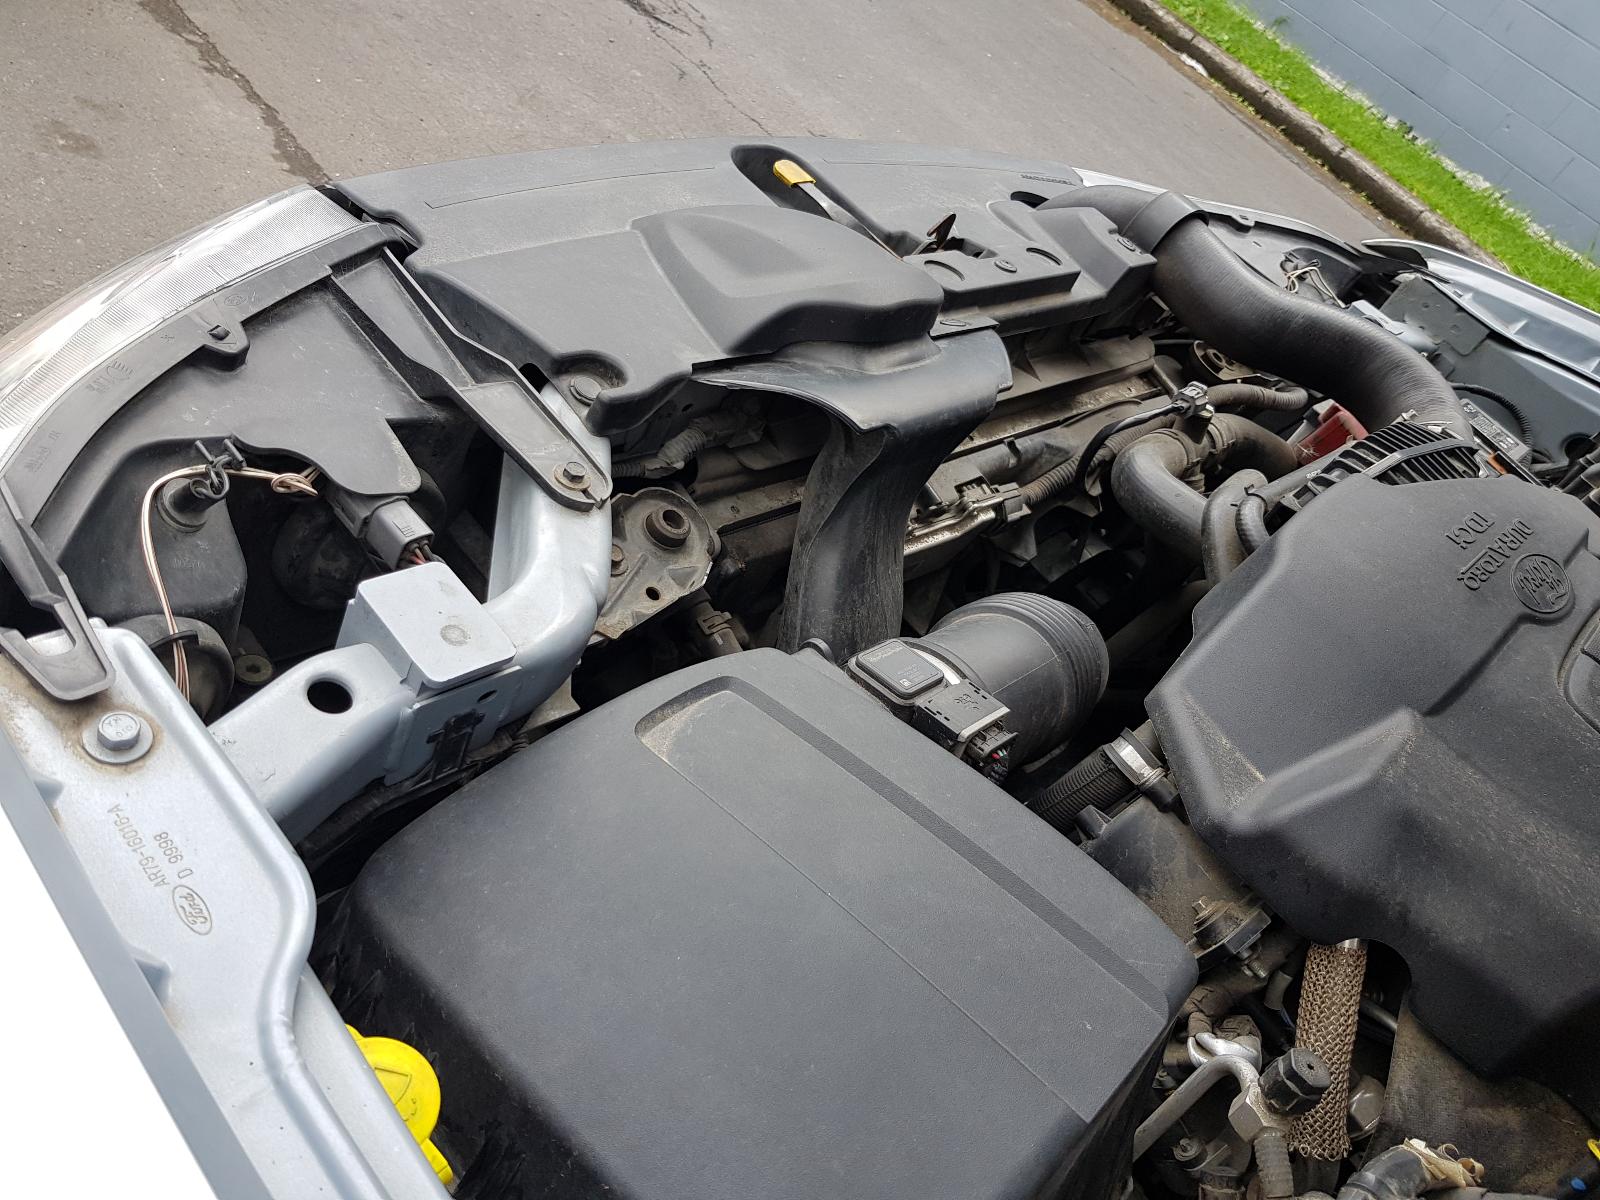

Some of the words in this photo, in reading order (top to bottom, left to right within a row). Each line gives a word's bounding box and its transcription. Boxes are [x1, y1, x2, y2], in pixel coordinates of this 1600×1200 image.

[1457, 519, 1534, 591] DURATORQ
[107, 803, 170, 887] AR79-16016-A
[154, 831, 183, 864] 9998
[176, 889, 210, 930] Ford
